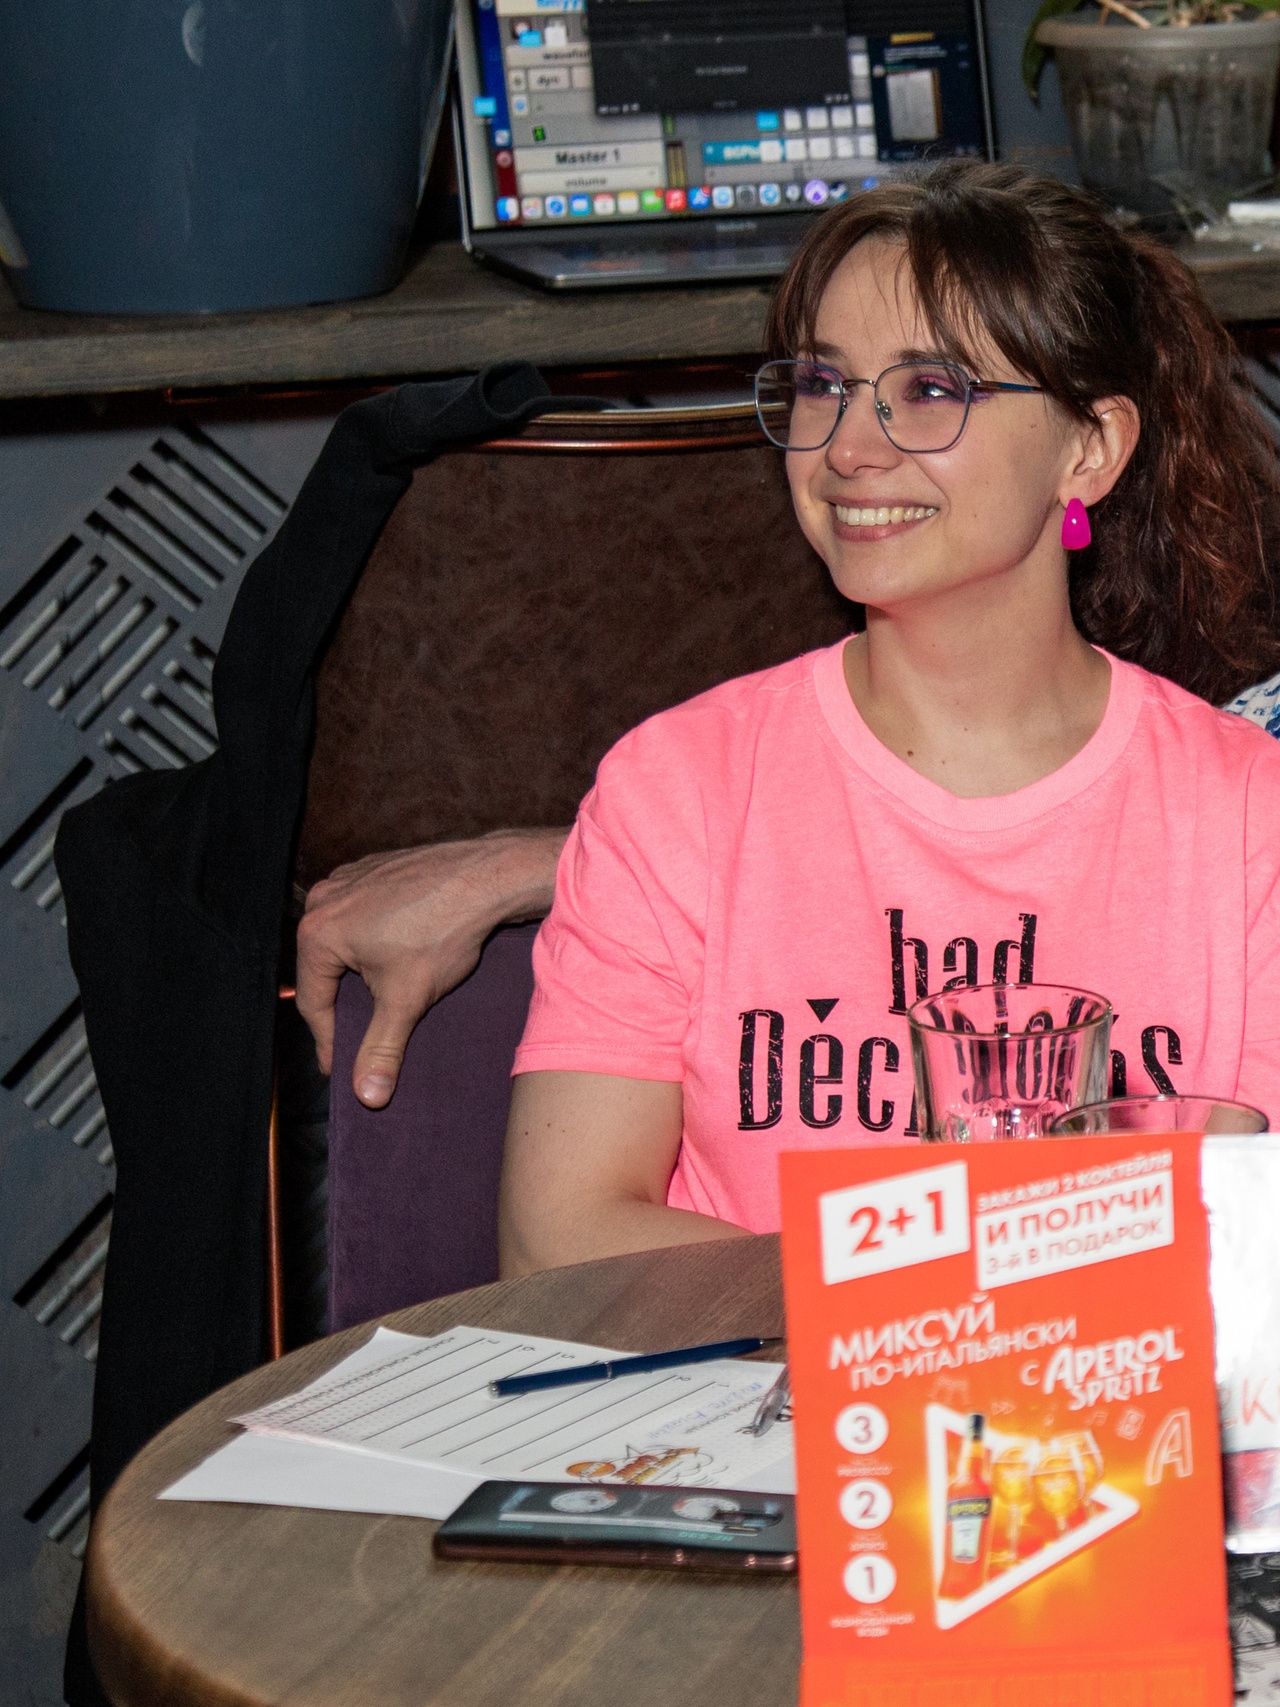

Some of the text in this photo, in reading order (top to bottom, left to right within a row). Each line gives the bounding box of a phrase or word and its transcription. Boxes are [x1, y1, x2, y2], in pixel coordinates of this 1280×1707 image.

[555, 150, 607, 165] Master
[977, 1150, 1173, 1212] ЗАКАЖИ 2 КОКТЕЙЛЯ
[848, 1190, 946, 1256] 2+1
[987, 1184, 1163, 1247] И ПОЛУЧИ
[1047, 1217, 1163, 1258] ПОДАРОК
[829, 1292, 996, 1371] МИКСУЙ
[850, 1314, 1078, 1392] ПО-ИТАЛЬЯНСКИ
[1043, 1327, 1185, 1395] APEROL
[853, 1415, 872, 1444] 3
[857, 1490, 876, 1520] 2
[864, 1566, 875, 1595] 1
